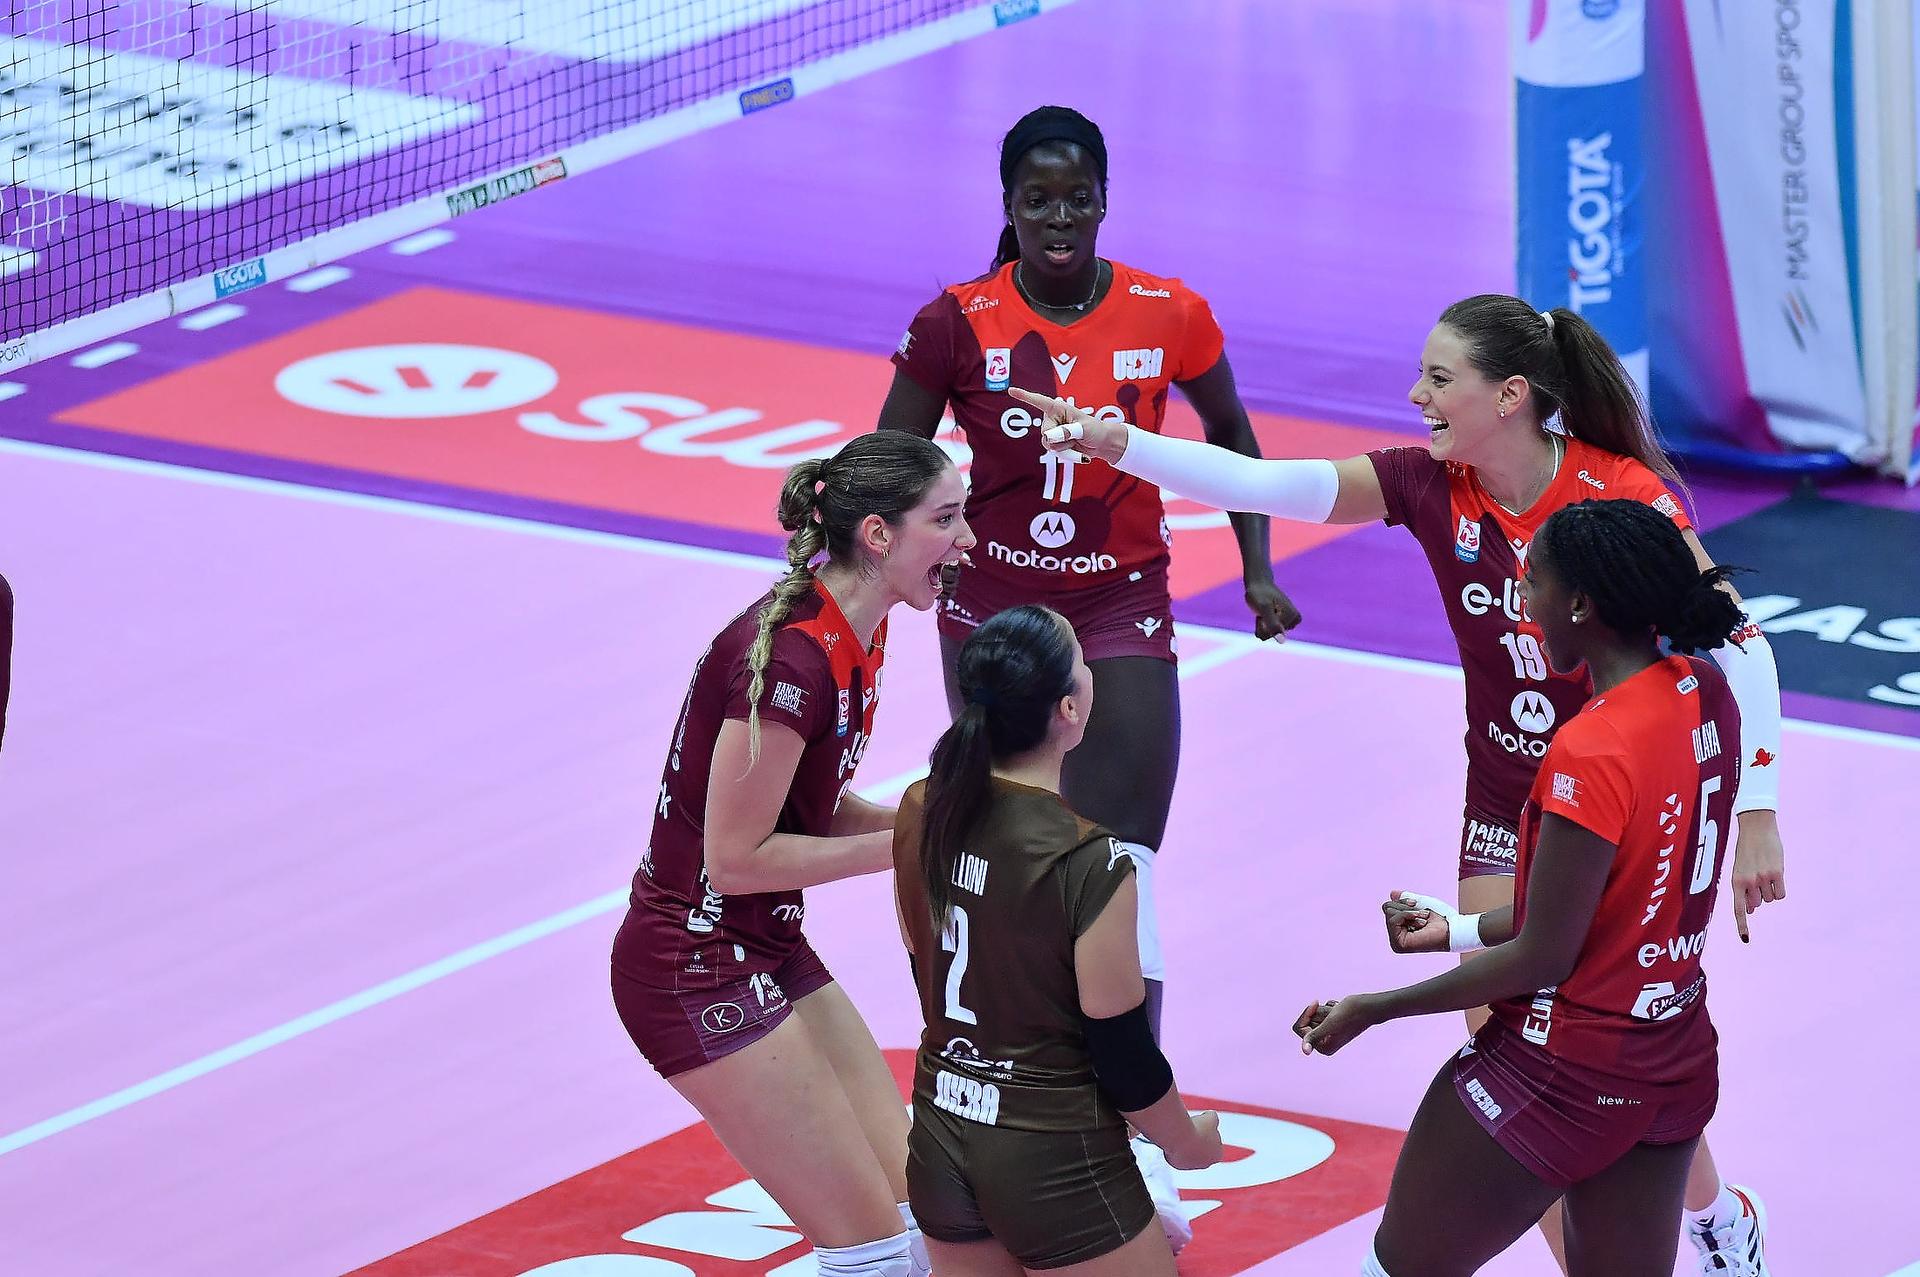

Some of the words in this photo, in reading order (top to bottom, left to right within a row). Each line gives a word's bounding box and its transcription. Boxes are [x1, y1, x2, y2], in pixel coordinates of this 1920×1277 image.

[1775, 0, 1803, 59] SPO
[1778, 63, 1807, 167] GROUP
[1782, 170, 1810, 280] MASTER
[1040, 450, 1075, 504] 11
[988, 541, 1118, 574] motorola
[1500, 632, 1547, 681] 19
[1489, 722, 1551, 757] moto
[1692, 720, 1721, 764] OLAYA
[1690, 776, 1722, 895] 5
[942, 905, 977, 1025] 2
[713, 1009, 731, 1027] K
[1597, 1095, 1625, 1105] New
